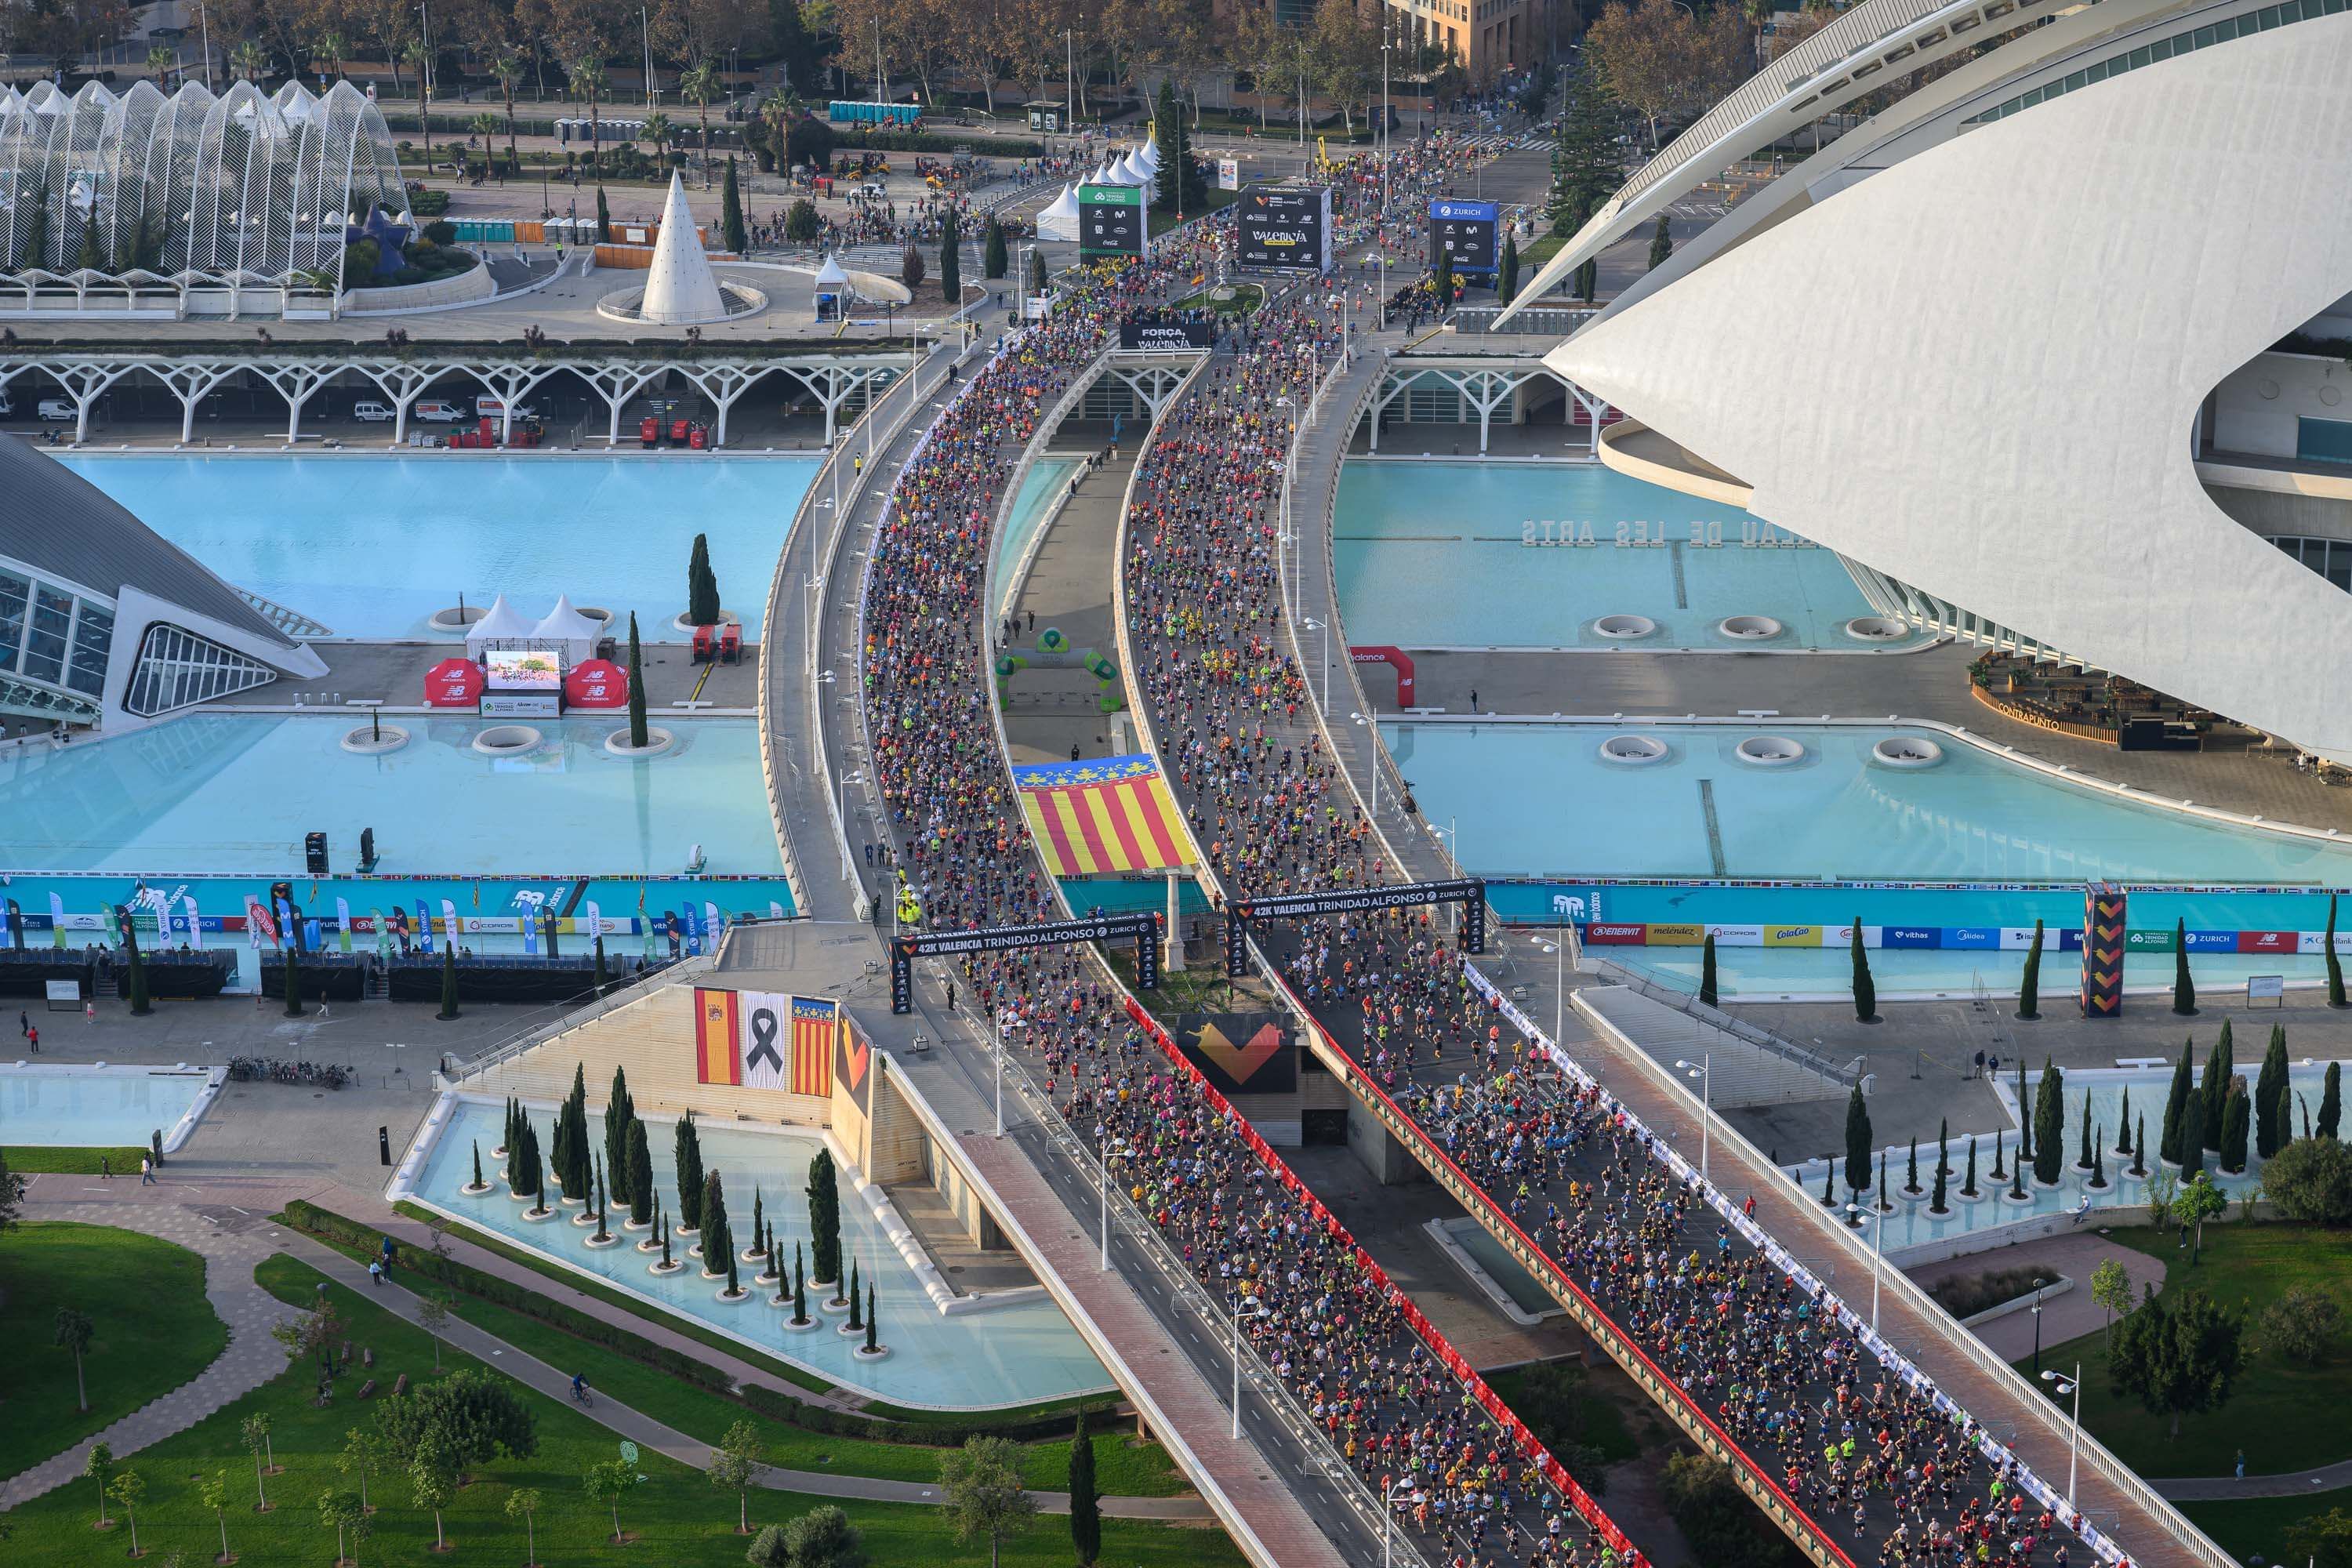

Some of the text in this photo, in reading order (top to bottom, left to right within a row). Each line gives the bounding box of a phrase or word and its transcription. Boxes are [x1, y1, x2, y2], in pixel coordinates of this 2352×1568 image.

[1142, 328, 1186, 338] FORÇA,
[1999, 702, 2059, 731] CONTRAPUNTO
[1271, 894, 1314, 902] VALENCIA
[1316, 888, 1368, 898] TRINIDAD
[1369, 883, 1422, 893] ALFONSO
[1254, 907, 1272, 916] 42K
[1274, 902, 1316, 915] VALENCIA
[1317, 898, 1370, 912] TRINIDAD
[1370, 893, 1425, 906] ALFONSO
[936, 929, 981, 939] VALENCIA
[981, 924, 1036, 935] TRINIDAD
[1036, 919, 1093, 929] ALFONSO
[1777, 927, 1809, 939] ColaCao
[918, 925, 1137, 954] 42K VALENCIA TRINIDAD ALFONSO ZURICH
